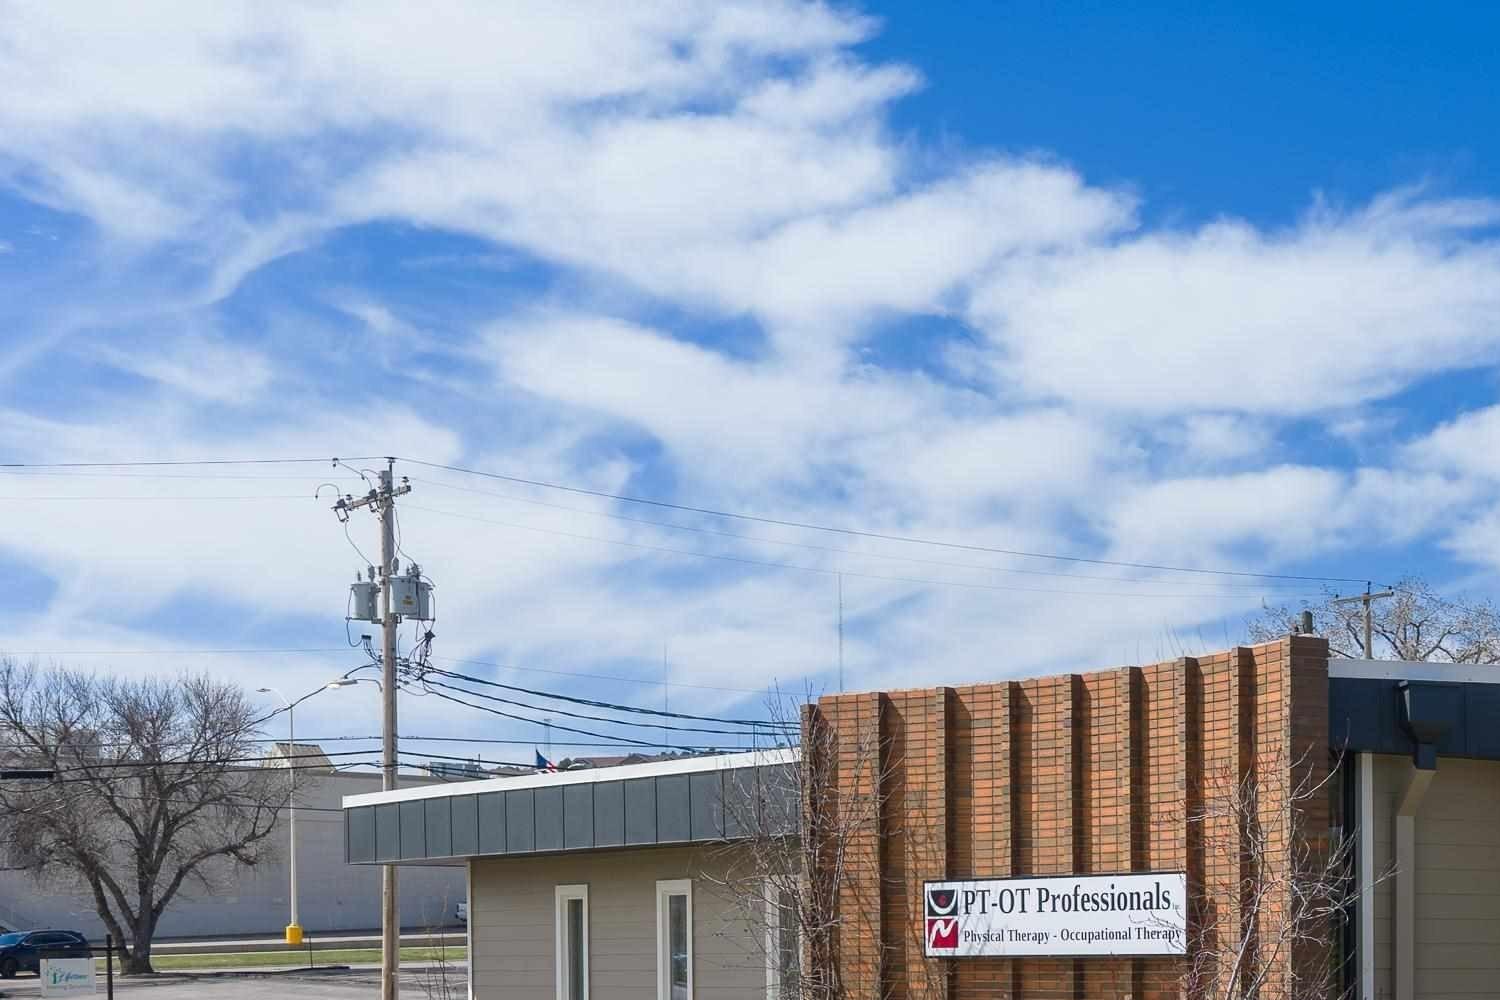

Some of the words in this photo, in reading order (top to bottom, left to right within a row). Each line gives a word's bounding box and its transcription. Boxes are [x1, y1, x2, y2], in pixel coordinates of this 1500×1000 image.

[963, 888, 1030, 914] PT-OT
[1036, 882, 1171, 914] Professionals
[963, 928, 1004, 943] Physical
[1007, 928, 1050, 944] Therapy
[1060, 927, 1131, 944] Occupational
[1135, 926, 1182, 943] Therapy
